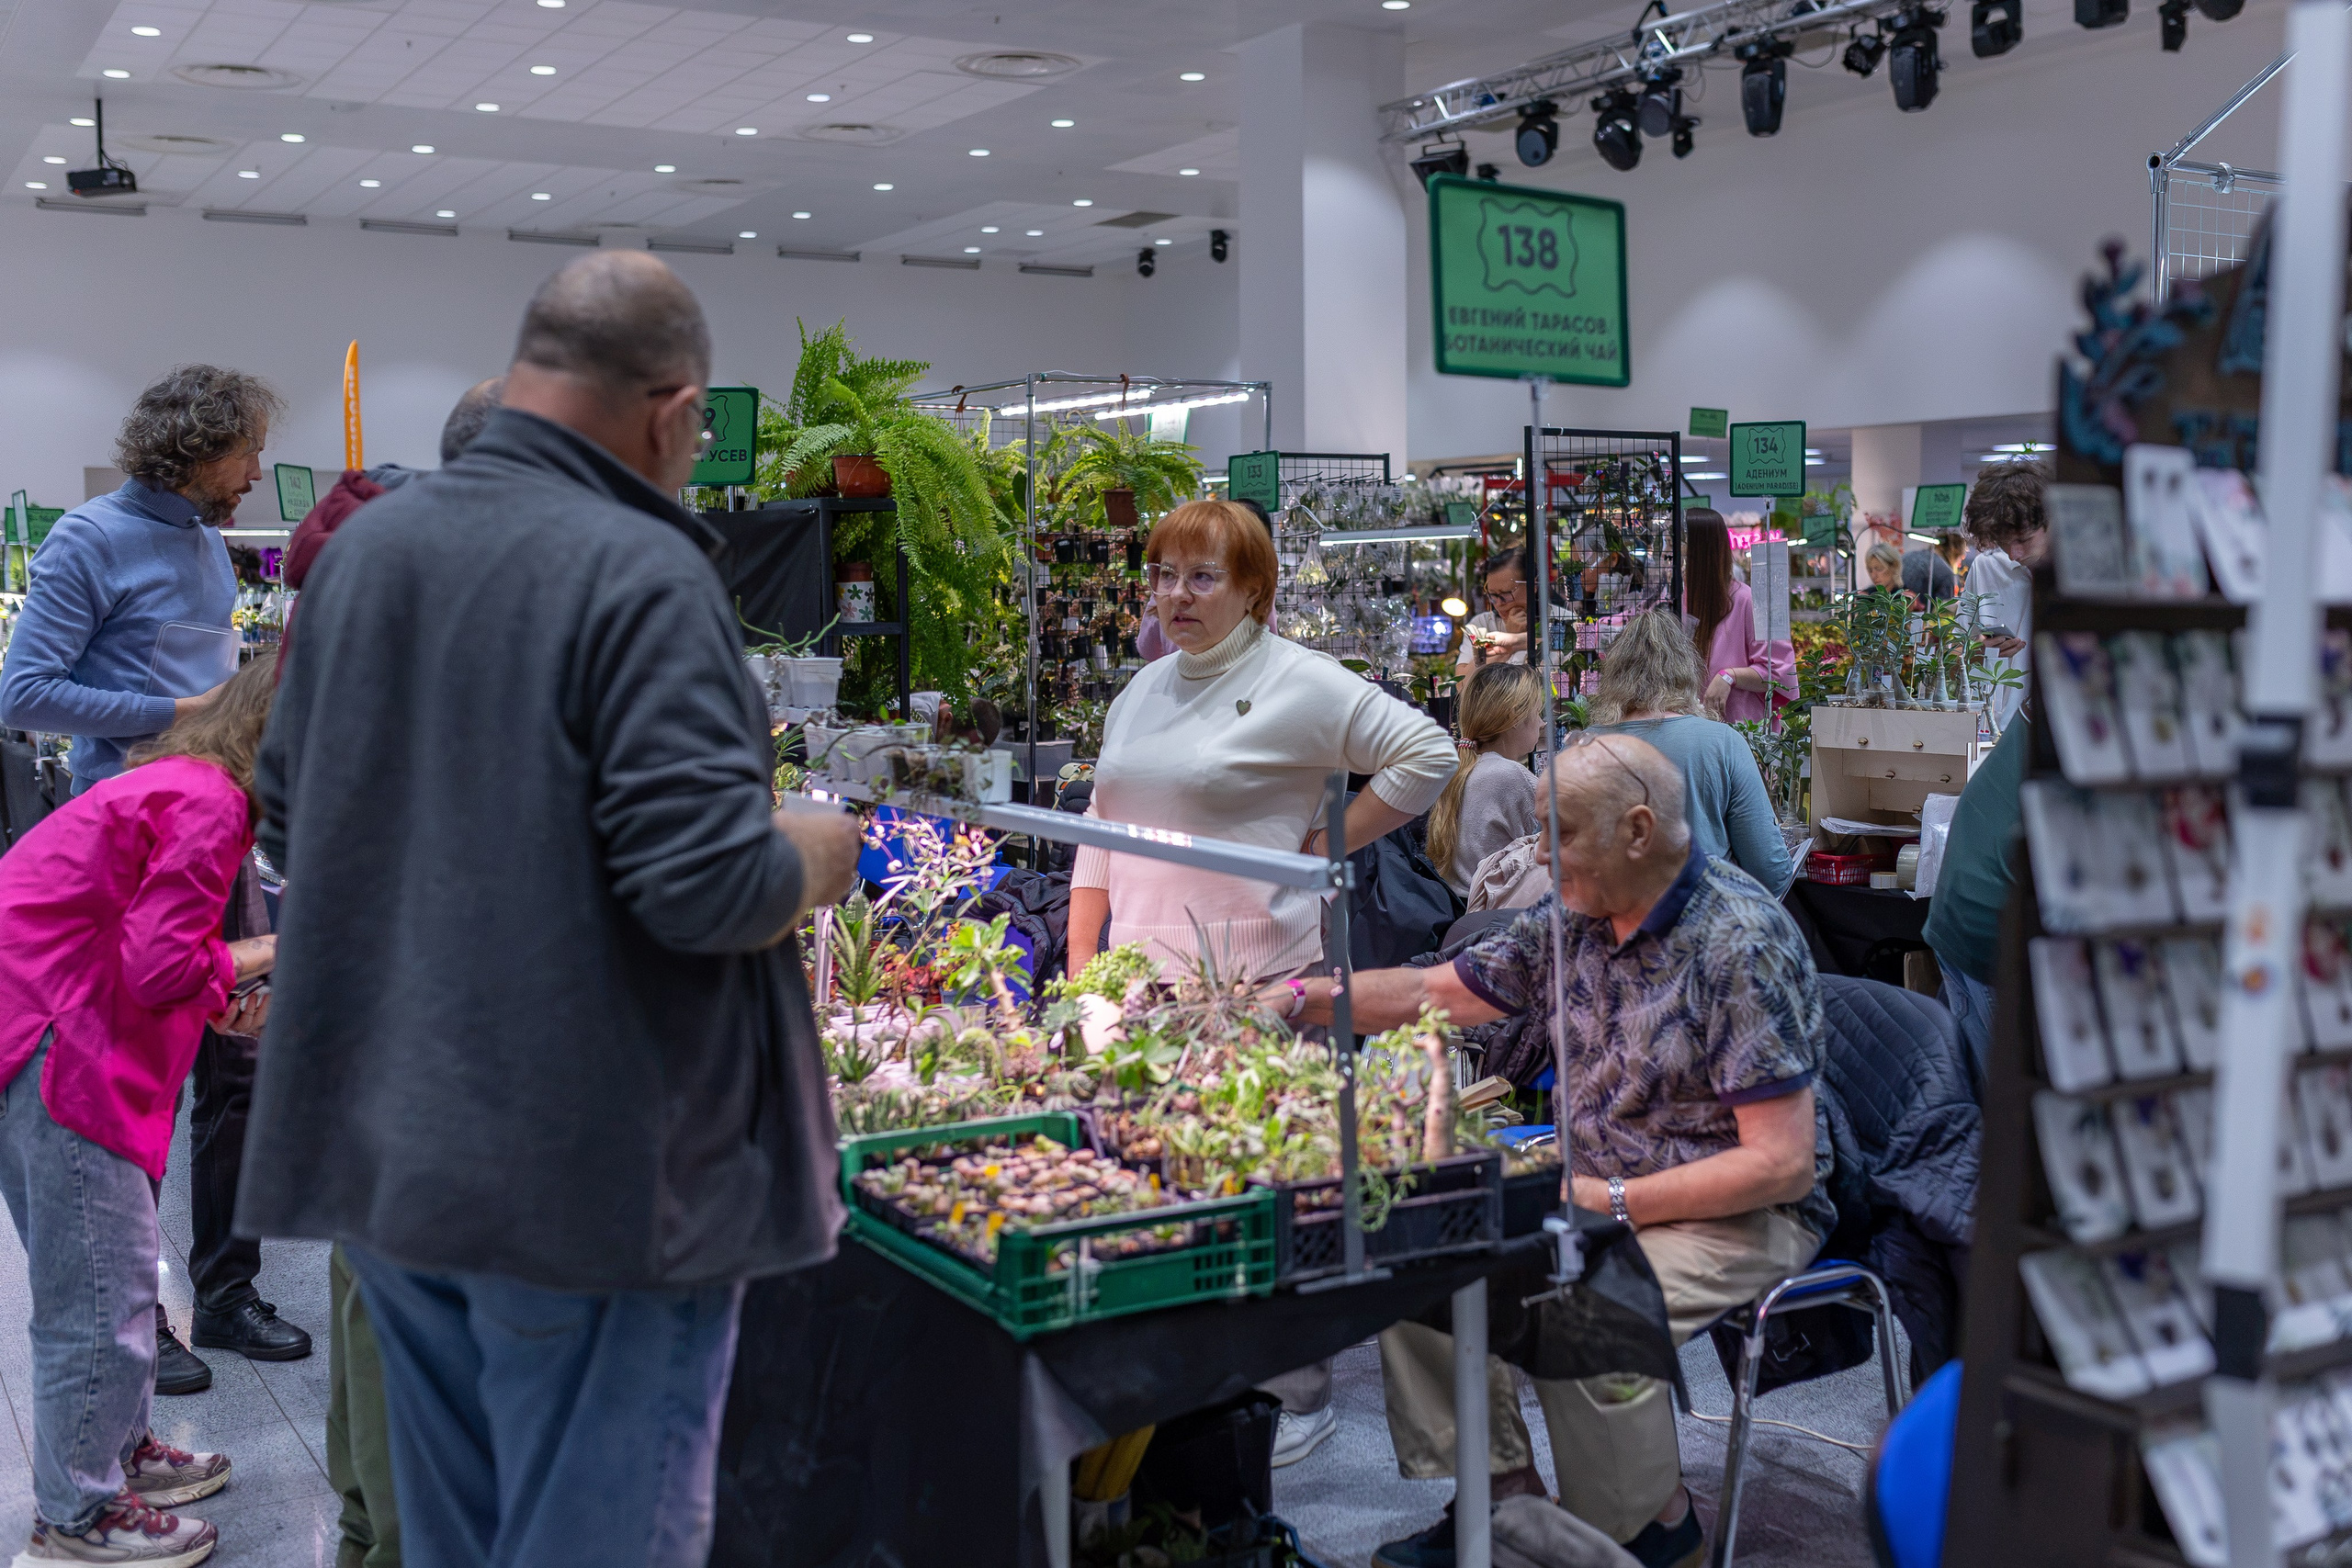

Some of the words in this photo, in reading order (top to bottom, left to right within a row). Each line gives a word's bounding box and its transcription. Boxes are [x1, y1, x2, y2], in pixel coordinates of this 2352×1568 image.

[1497, 224, 1560, 271] 138
[1448, 305, 1526, 329] ЕВГЕНИЙ
[1532, 310, 1607, 334] ТАРАСОВ
[1754, 436, 1778, 454] 134
[701, 449, 748, 462] УСЕВ
[1746, 468, 1787, 479] АДЕНИУМ
